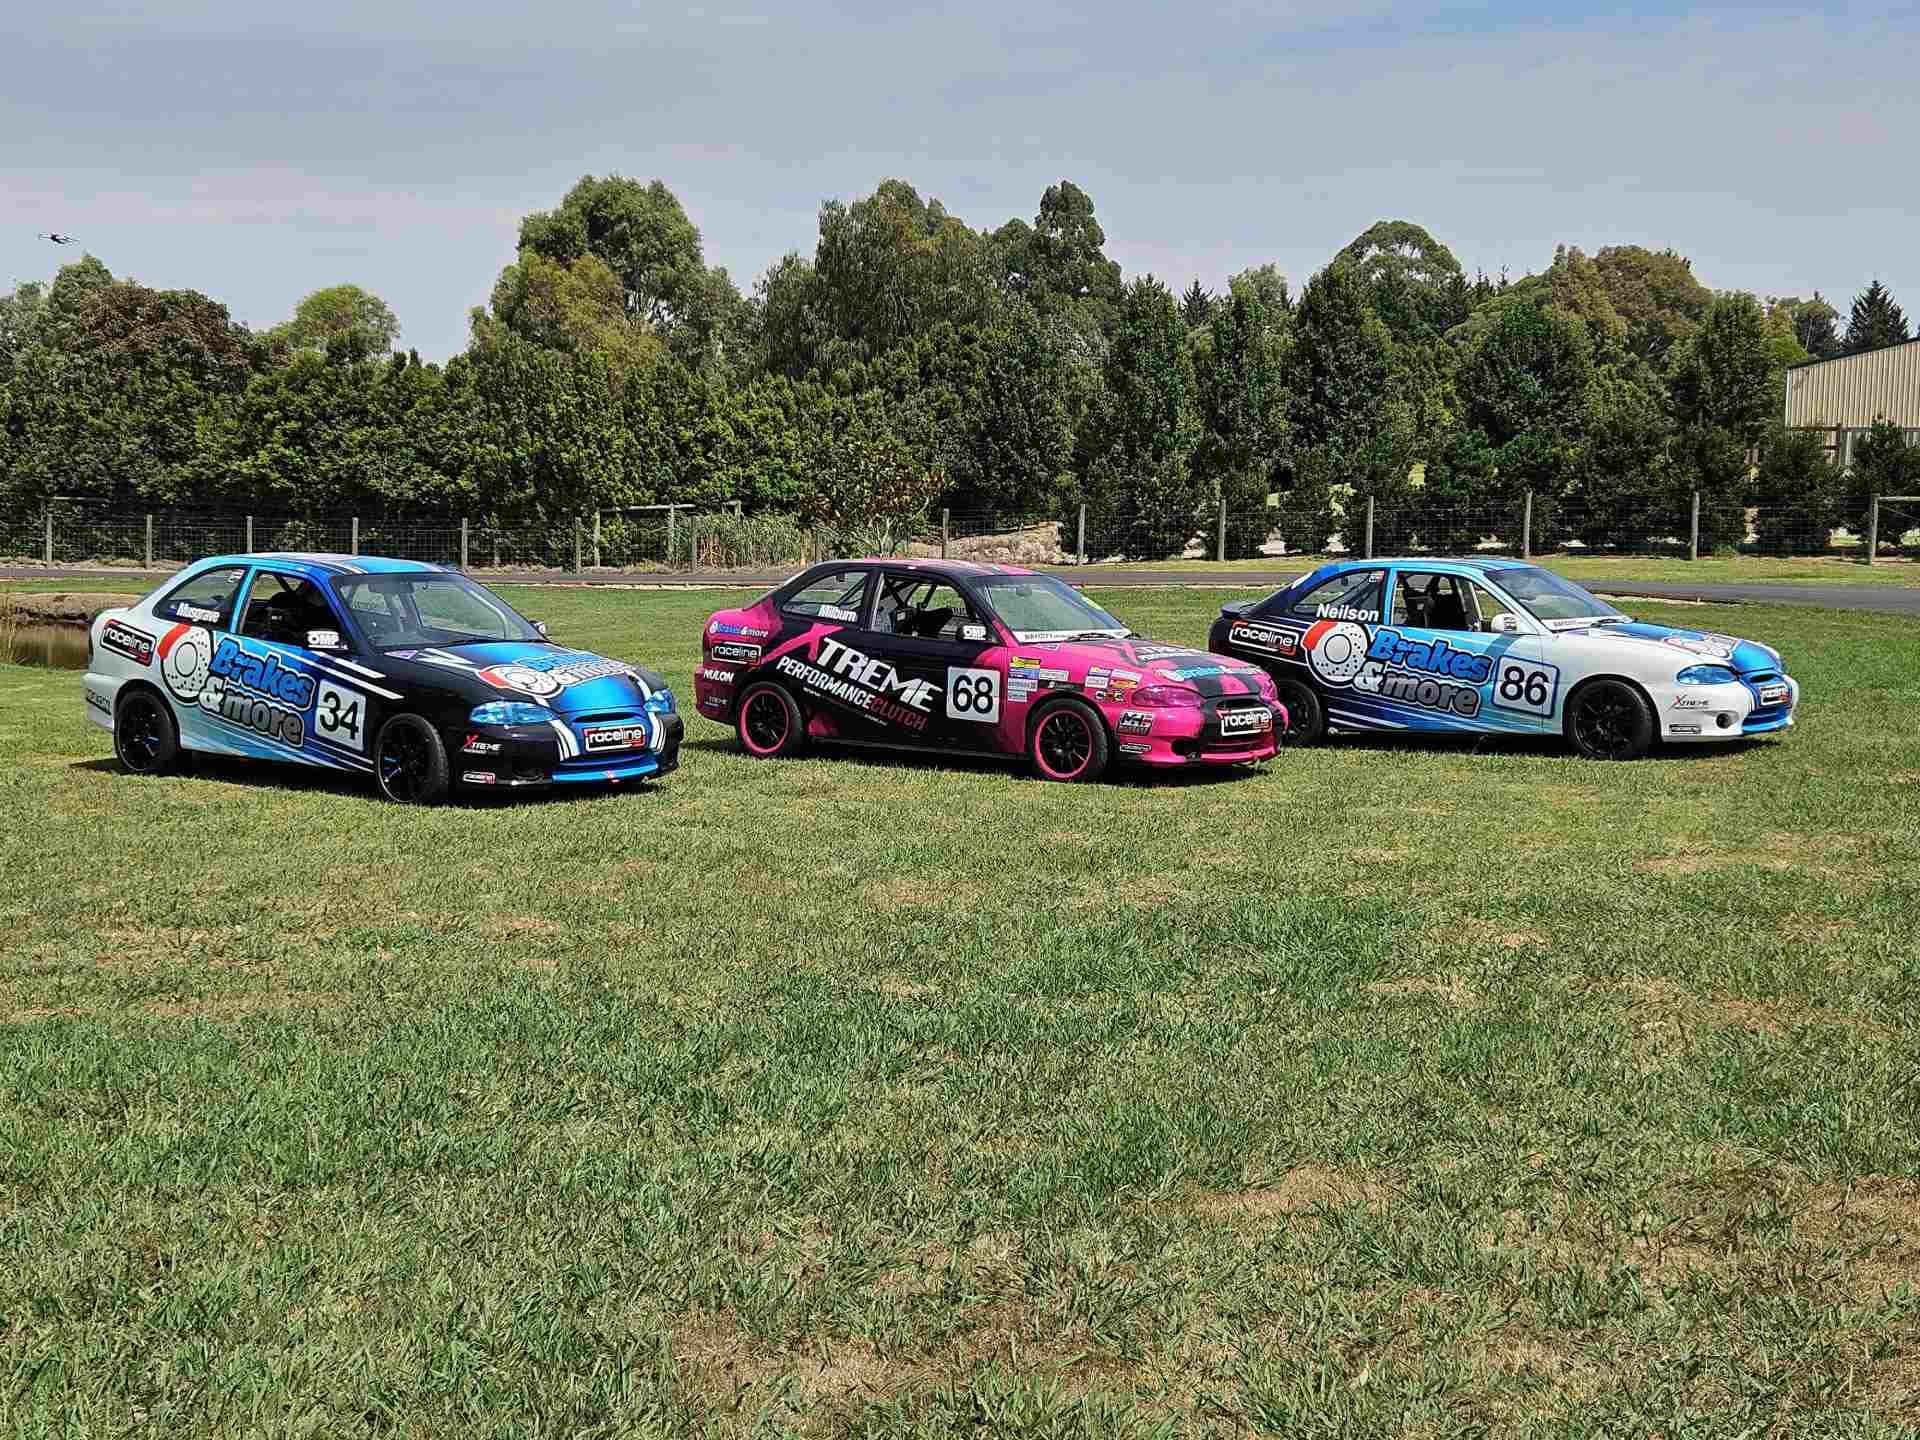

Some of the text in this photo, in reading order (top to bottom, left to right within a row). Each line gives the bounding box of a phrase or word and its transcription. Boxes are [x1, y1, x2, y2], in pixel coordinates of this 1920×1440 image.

[1315, 603, 1380, 622] Neilson
[104, 627, 150, 653] raceline
[1234, 627, 1293, 647] raceline
[714, 645, 757, 659] raceline
[1366, 629, 1492, 683] Brakes
[209, 637, 312, 707] Brakes
[704, 669, 734, 682] NULON
[953, 674, 994, 714] 68
[1500, 665, 1550, 706] 86
[319, 691, 359, 739] 34
[1224, 712, 1269, 727] raceline
[590, 728, 642, 743] raceline
